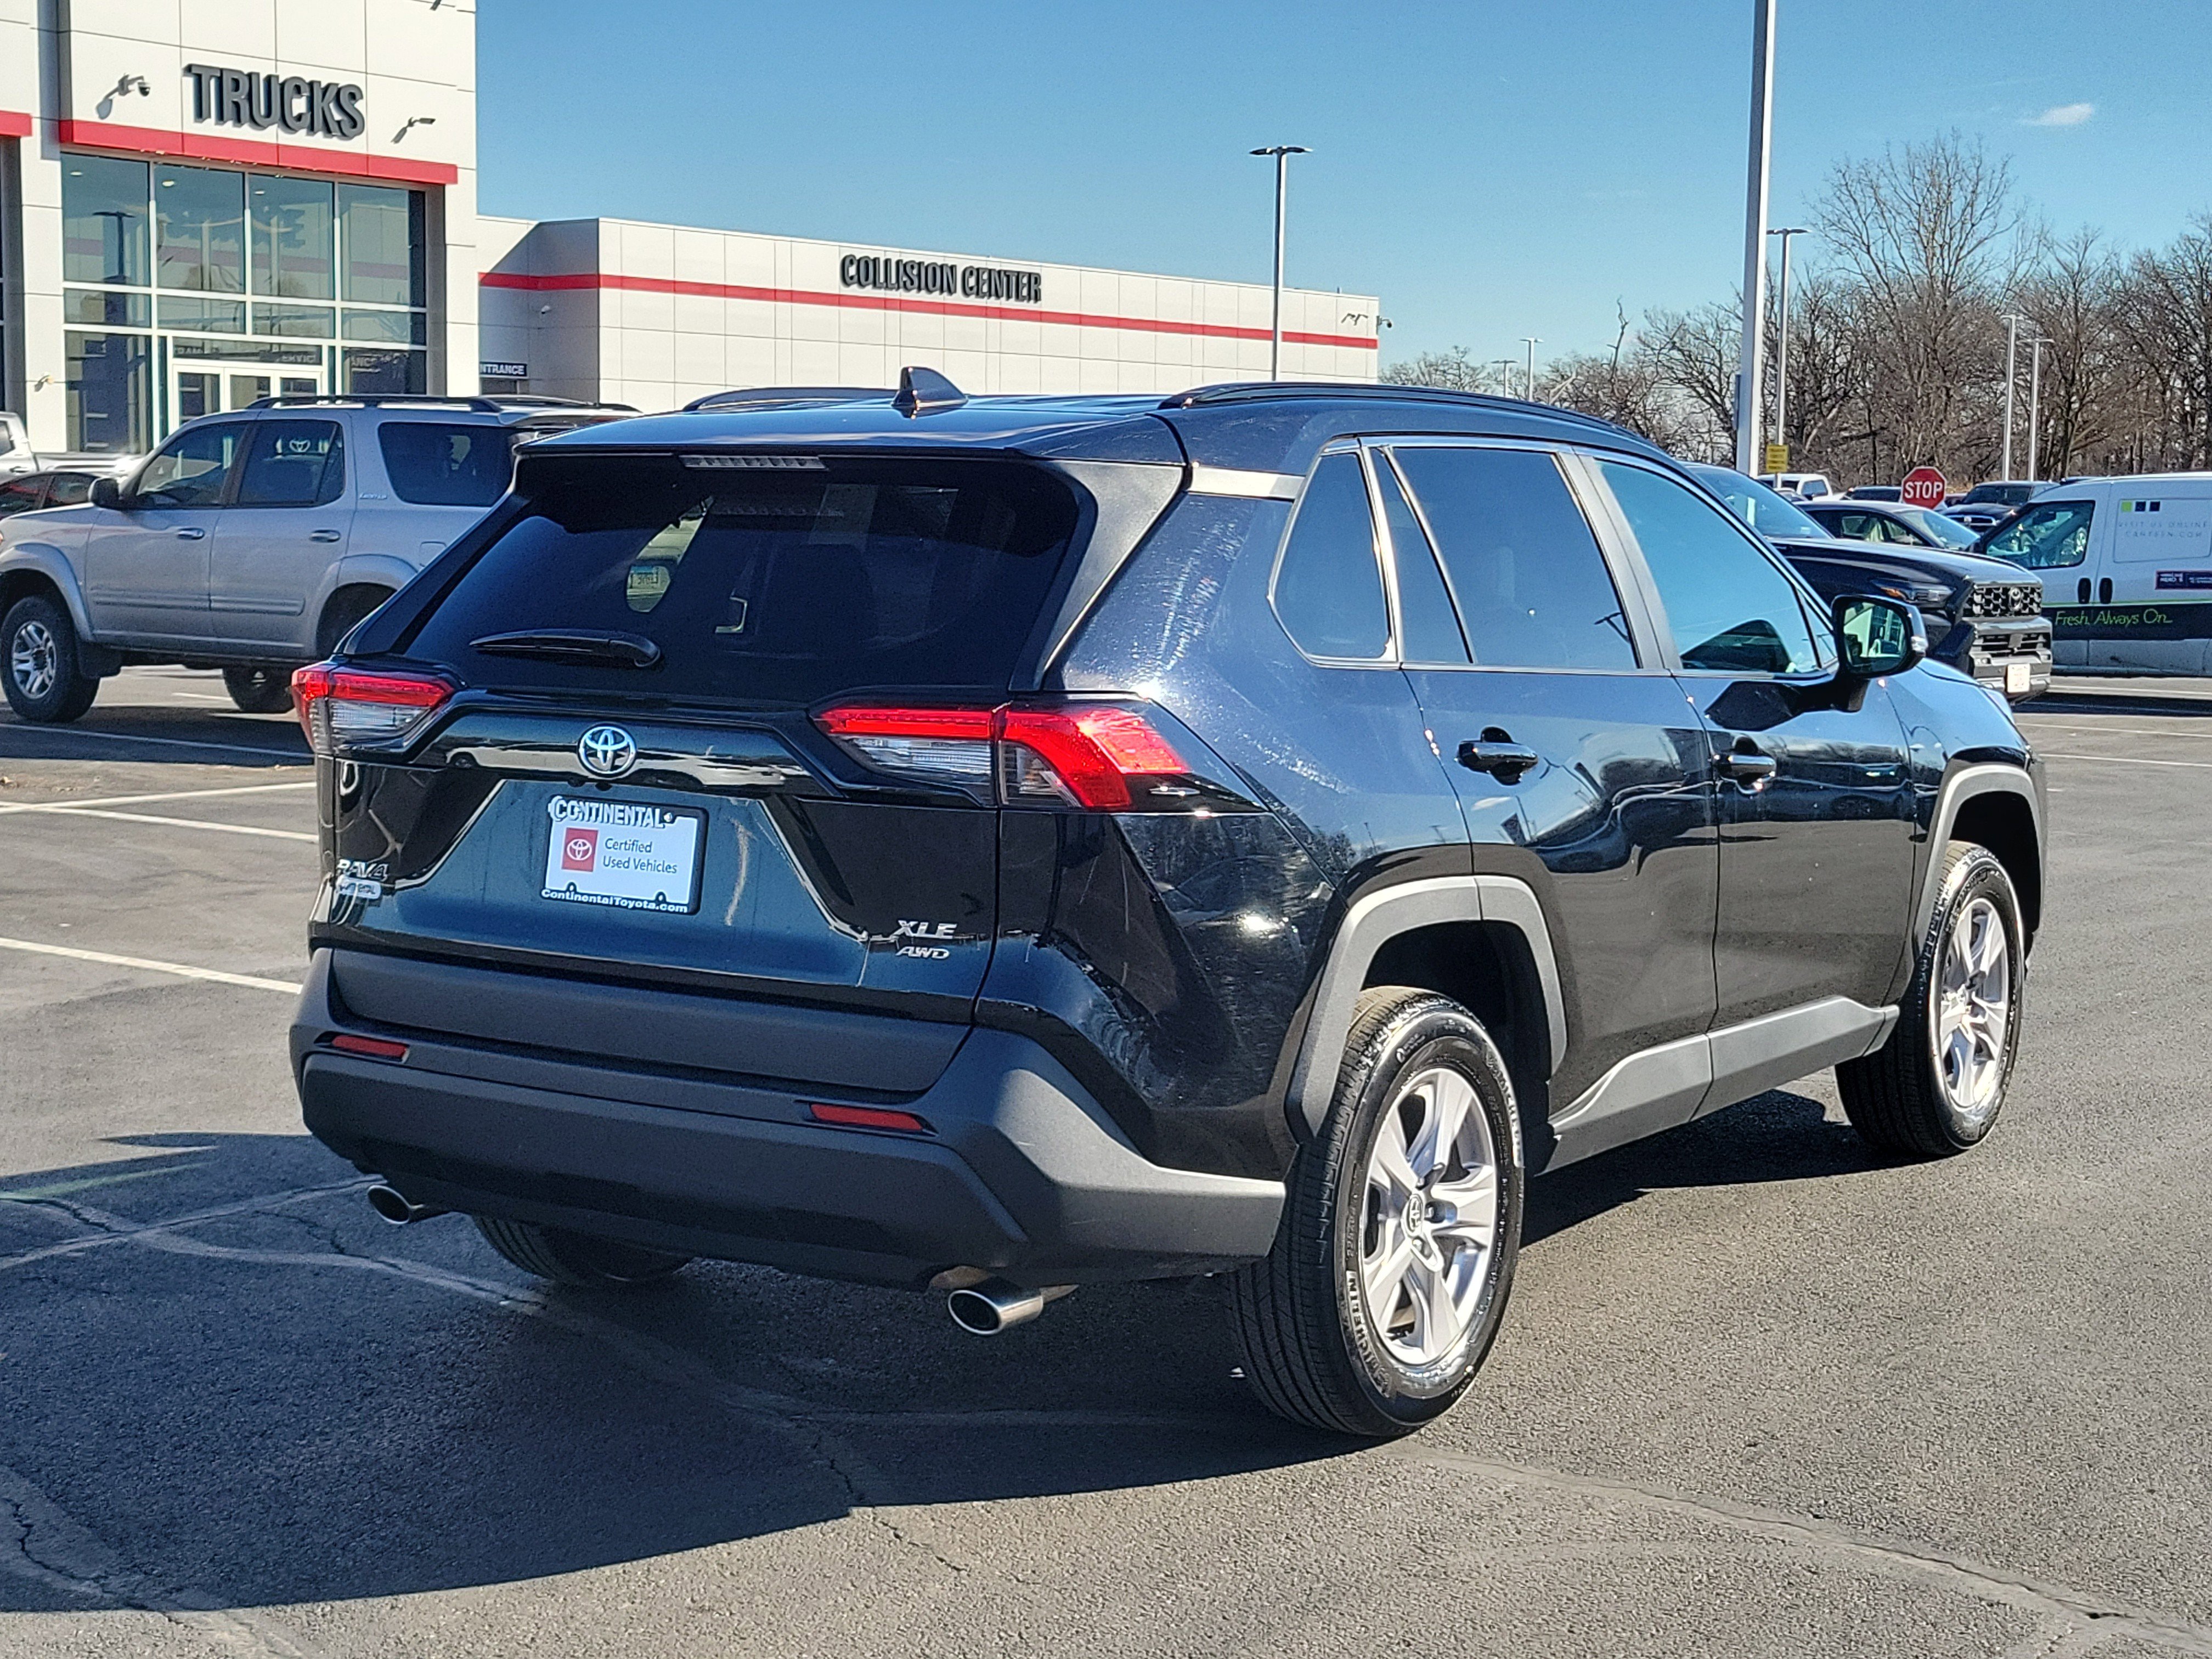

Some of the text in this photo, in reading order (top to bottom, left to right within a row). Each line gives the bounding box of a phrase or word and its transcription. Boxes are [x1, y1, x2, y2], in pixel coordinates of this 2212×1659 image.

[183, 63, 365, 141] TRUCKS
[840, 254, 1042, 303] COLLISION CENTER
[480, 364, 524, 375] NTRANCE
[1904, 481, 1943, 499] STOP
[548, 795, 665, 828] CONTINENTAL
[605, 838, 653, 853] Certified
[603, 856, 678, 873] Used Vehicles
[541, 889, 688, 913] ContinentalToyota.com
[891, 920, 958, 939] XLE
[895, 946, 951, 959] AWD
